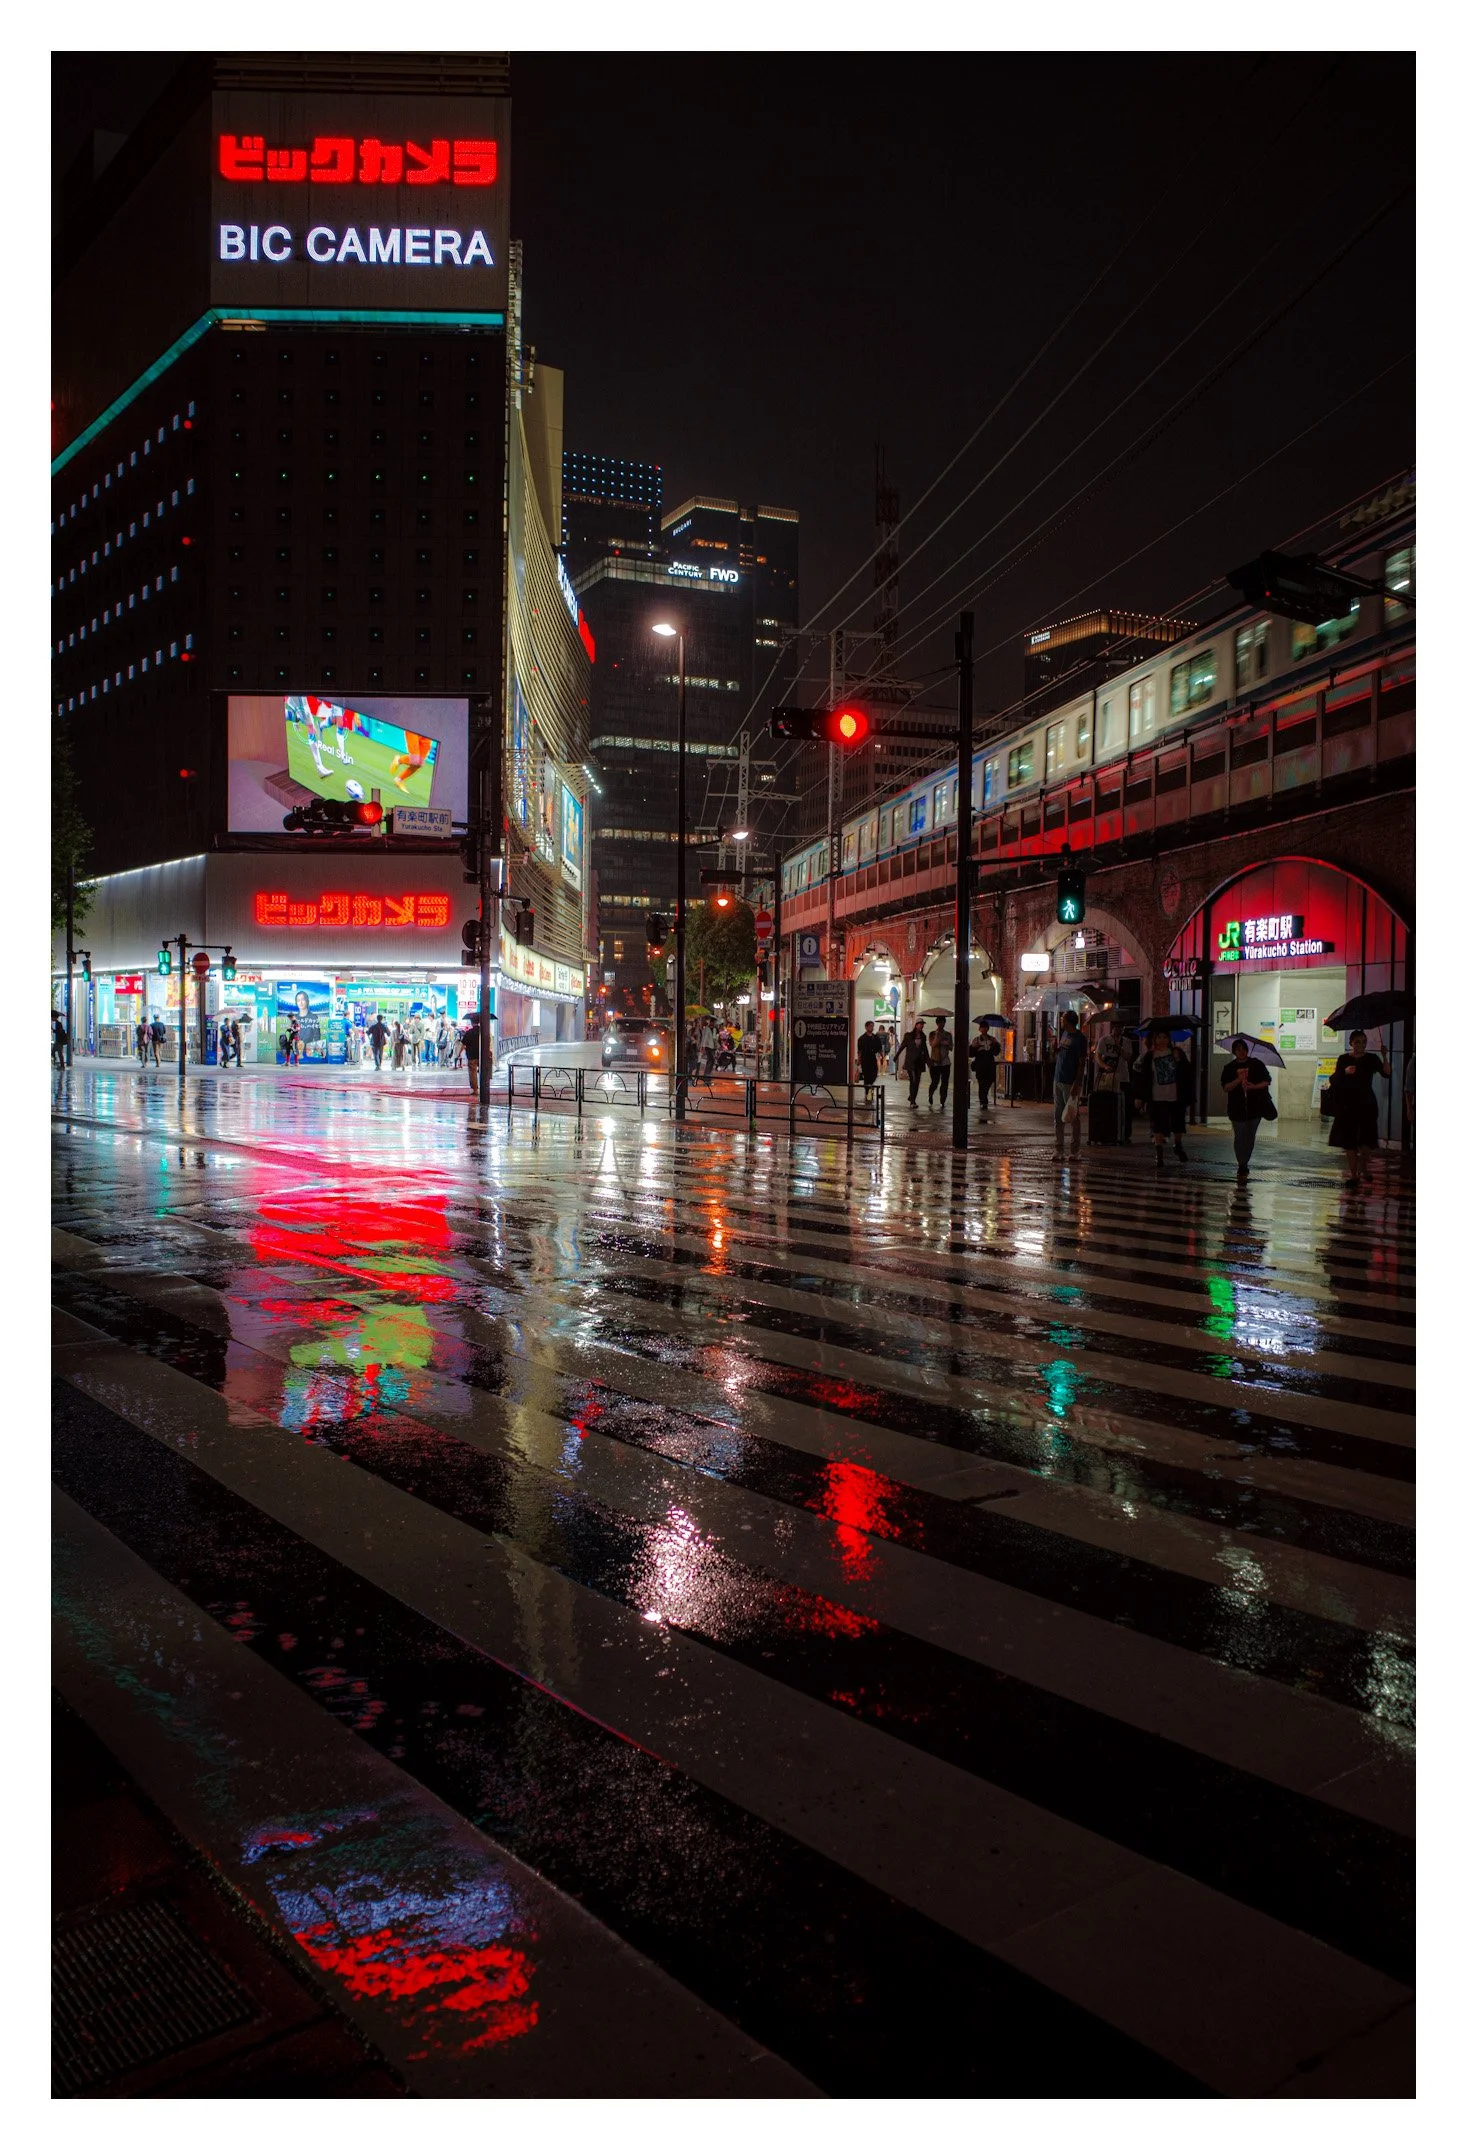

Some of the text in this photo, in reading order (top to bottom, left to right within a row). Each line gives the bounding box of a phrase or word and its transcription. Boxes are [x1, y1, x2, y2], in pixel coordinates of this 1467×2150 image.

[219, 134, 498, 184] ビックカメラ
[219, 224, 495, 265] BIC CAMERA
[668, 567, 703, 578] CENTURY
[672, 562, 739, 583] PACIFIC FWD
[317, 740, 335, 755] Real
[397, 810, 449, 825] 有楽町駅前
[256, 893, 450, 927] ビックカメラ
[1218, 921, 1241, 949] JR
[1244, 915, 1293, 944] 有楽町駅
[1244, 939, 1323, 960] Yūrakuchō Station
